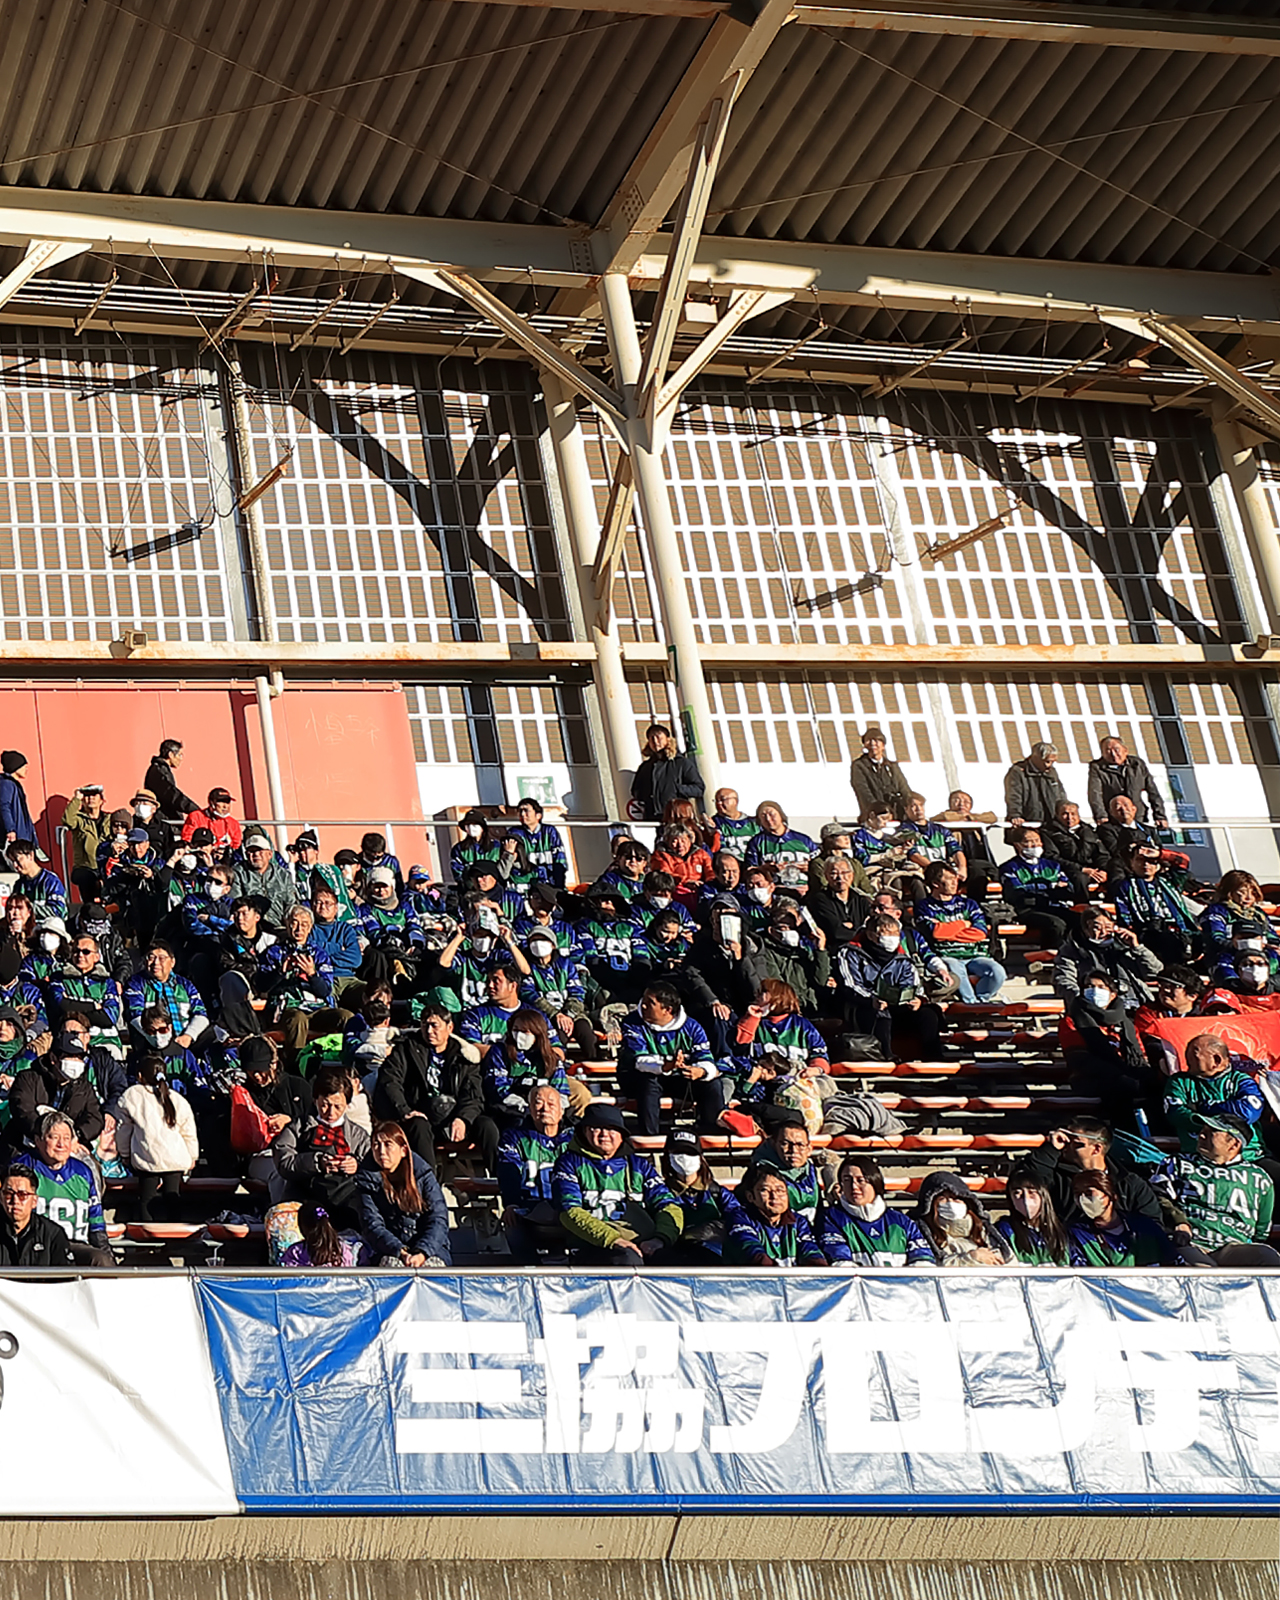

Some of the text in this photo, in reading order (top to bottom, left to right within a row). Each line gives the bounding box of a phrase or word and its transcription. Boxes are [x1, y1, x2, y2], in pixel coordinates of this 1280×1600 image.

[1181, 1161, 1248, 1185] BORN
[395, 1313, 1280, 1453] 三協フロンテ
